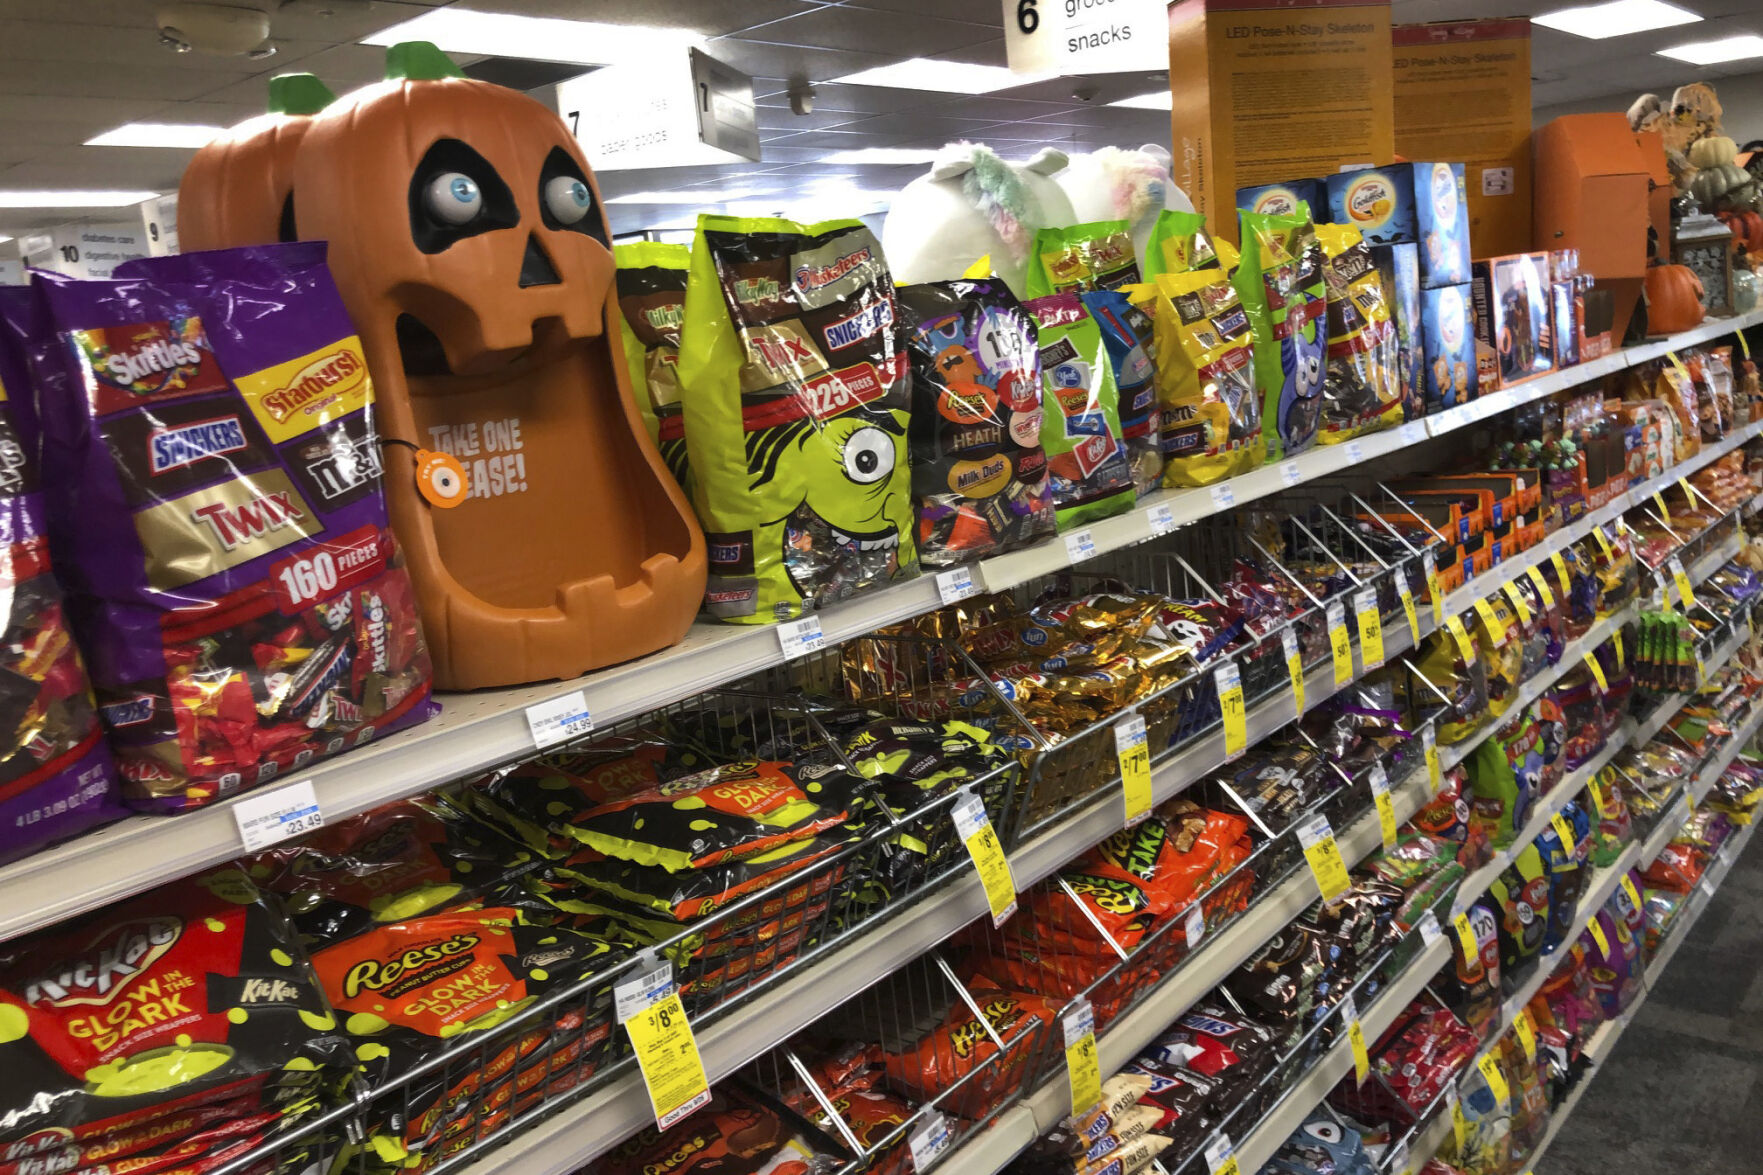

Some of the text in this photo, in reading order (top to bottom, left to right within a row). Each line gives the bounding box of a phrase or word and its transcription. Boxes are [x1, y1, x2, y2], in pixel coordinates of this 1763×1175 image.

[1017, 0, 1039, 35] 6
[1226, 26, 1249, 39] LED
[1327, 22, 1375, 34] Skeleton
[1068, 25, 1132, 53] snacks
[1393, 58, 1408, 69] ED
[568, 111, 580, 138] 7
[1353, 188, 1386, 211] Goldfish
[82, 233, 135, 245] diabetes care
[149, 222, 159, 242] 9
[60, 245, 79, 263] 10
[85, 250, 119, 261] digestive
[796, 246, 871, 294] 3 Musketeers
[108, 339, 201, 385] Skittles
[264, 351, 362, 418] Starburst
[803, 376, 875, 417] 225 PIECES
[303, 394, 338, 415] Original
[154, 419, 246, 470] SNICKERS
[428, 418, 523, 457] TAKE ONE
[953, 426, 1002, 450] HEATH
[461, 453, 528, 499] EASE!
[958, 459, 1004, 489] Milk Duds
[279, 542, 378, 605] 160 PIECES
[1025, 631, 1044, 645] fun
[1043, 659, 1063, 671] fun
[16, 793, 82, 828] 4 LB 3.09 OZ
[1127, 821, 1165, 874] TAKE
[1473, 916, 1494, 940] 170
[345, 933, 482, 999] Reese's
[390, 957, 472, 997] PEANUT BUTTER CUPS
[68, 970, 196, 1038] GLOW IN THE
[239, 978, 299, 1003] KitKat
[403, 963, 497, 1016] GLOW IN THE
[429, 978, 502, 1016] DARK
[91, 993, 192, 1052] DARK
[441, 1008, 464, 1024] SNACK
[99, 1013, 202, 1063] SNACK SIZE WRAPPERS
[86, 1116, 195, 1160] GLOW DARK
